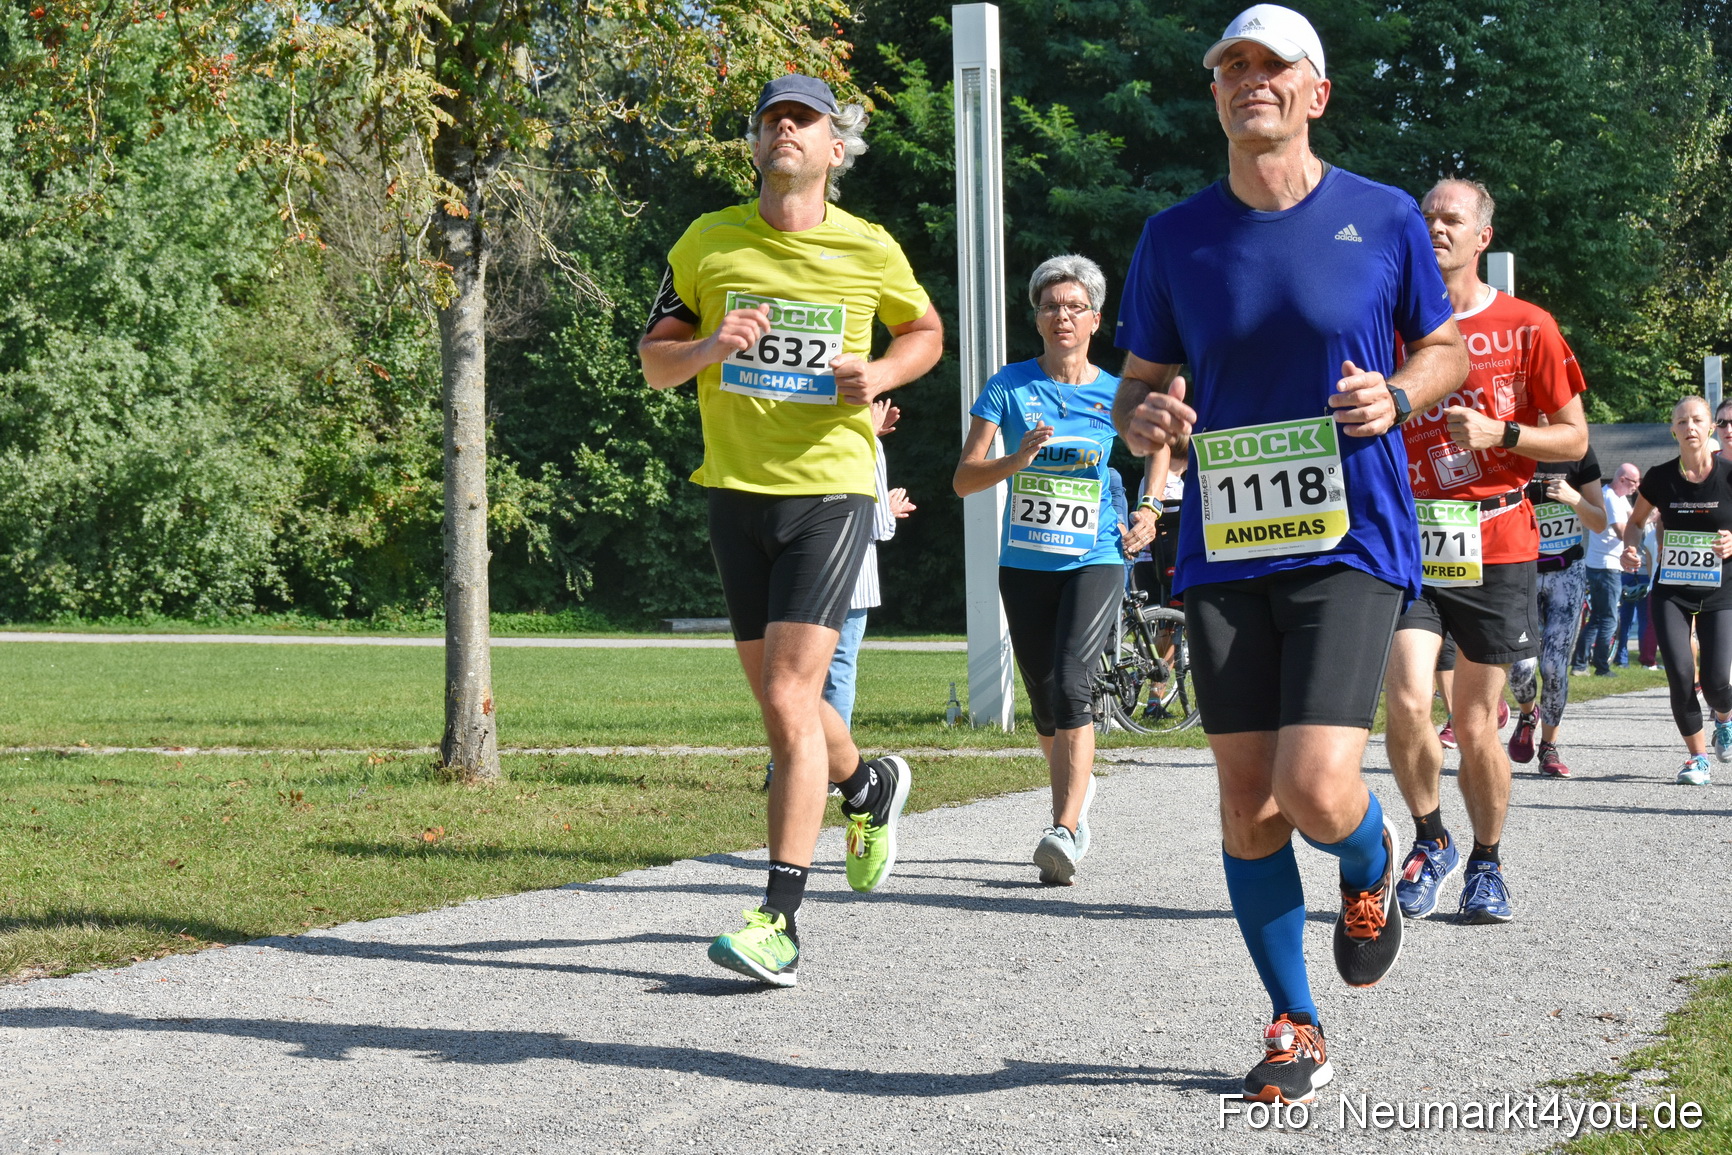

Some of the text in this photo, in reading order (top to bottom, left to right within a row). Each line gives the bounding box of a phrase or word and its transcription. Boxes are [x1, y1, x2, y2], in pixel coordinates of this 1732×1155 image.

[1335, 233, 1362, 243] adidas
[1461, 325, 1540, 356] aum
[740, 370, 818, 392] MICHAEL
[1203, 423, 1326, 466] BOCK
[1328, 467, 1335, 475] D
[1020, 475, 1094, 499] BOCK
[1217, 466, 1328, 514] 1118
[1020, 498, 1088, 530] 2370
[1415, 503, 1471, 524] OCK
[1534, 502, 1575, 519] OCK
[1028, 530, 1075, 546] INGRID
[1225, 518, 1326, 544] ANDREAS
[1667, 533, 1716, 547] BOCK
[1667, 549, 1715, 568] 2028
[1664, 570, 1715, 581] CHRISTINA
